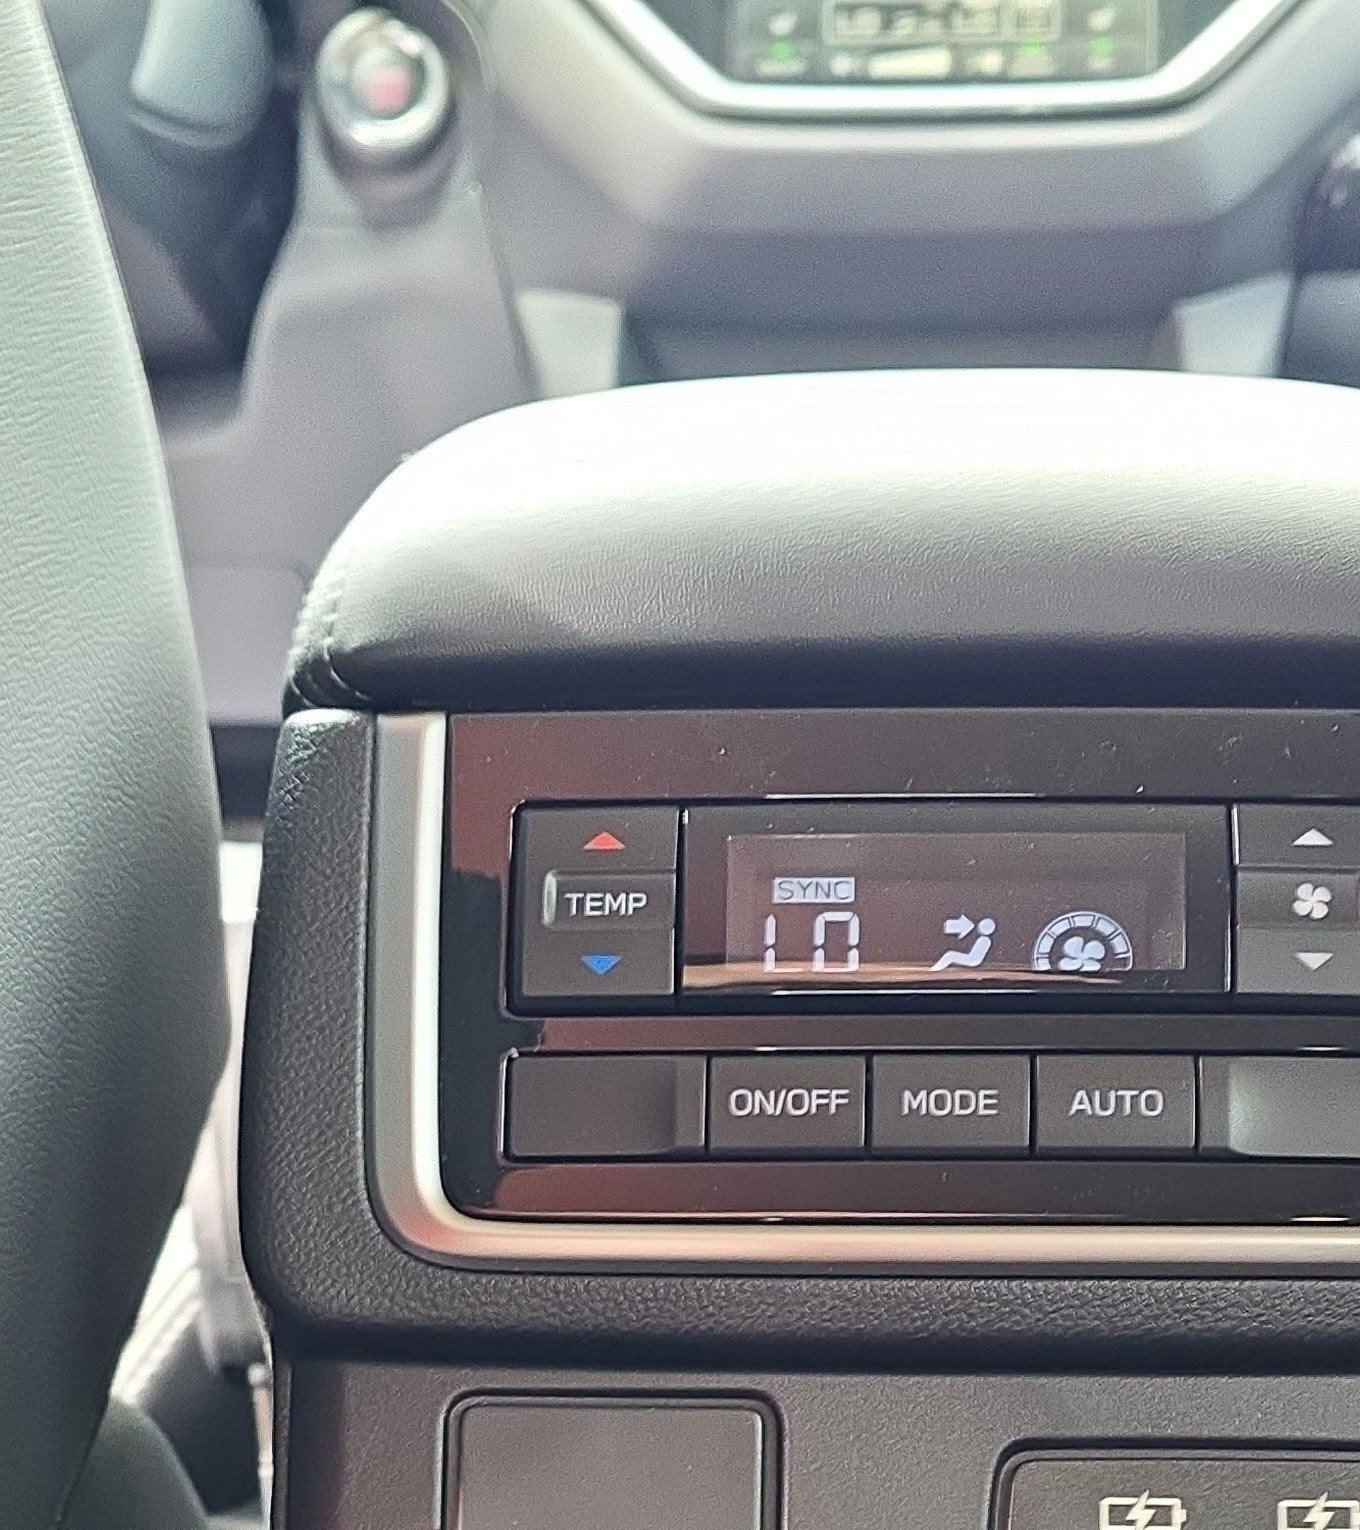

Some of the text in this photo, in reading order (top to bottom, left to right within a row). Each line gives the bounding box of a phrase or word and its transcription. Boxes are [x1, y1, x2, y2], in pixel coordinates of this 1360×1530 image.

[564, 891, 648, 918] TEMP
[777, 879, 852, 901] SYNC
[728, 1087, 851, 1117] ON/OFF
[901, 1087, 1000, 1117] MODE
[1067, 1087, 1165, 1117] AUTO
